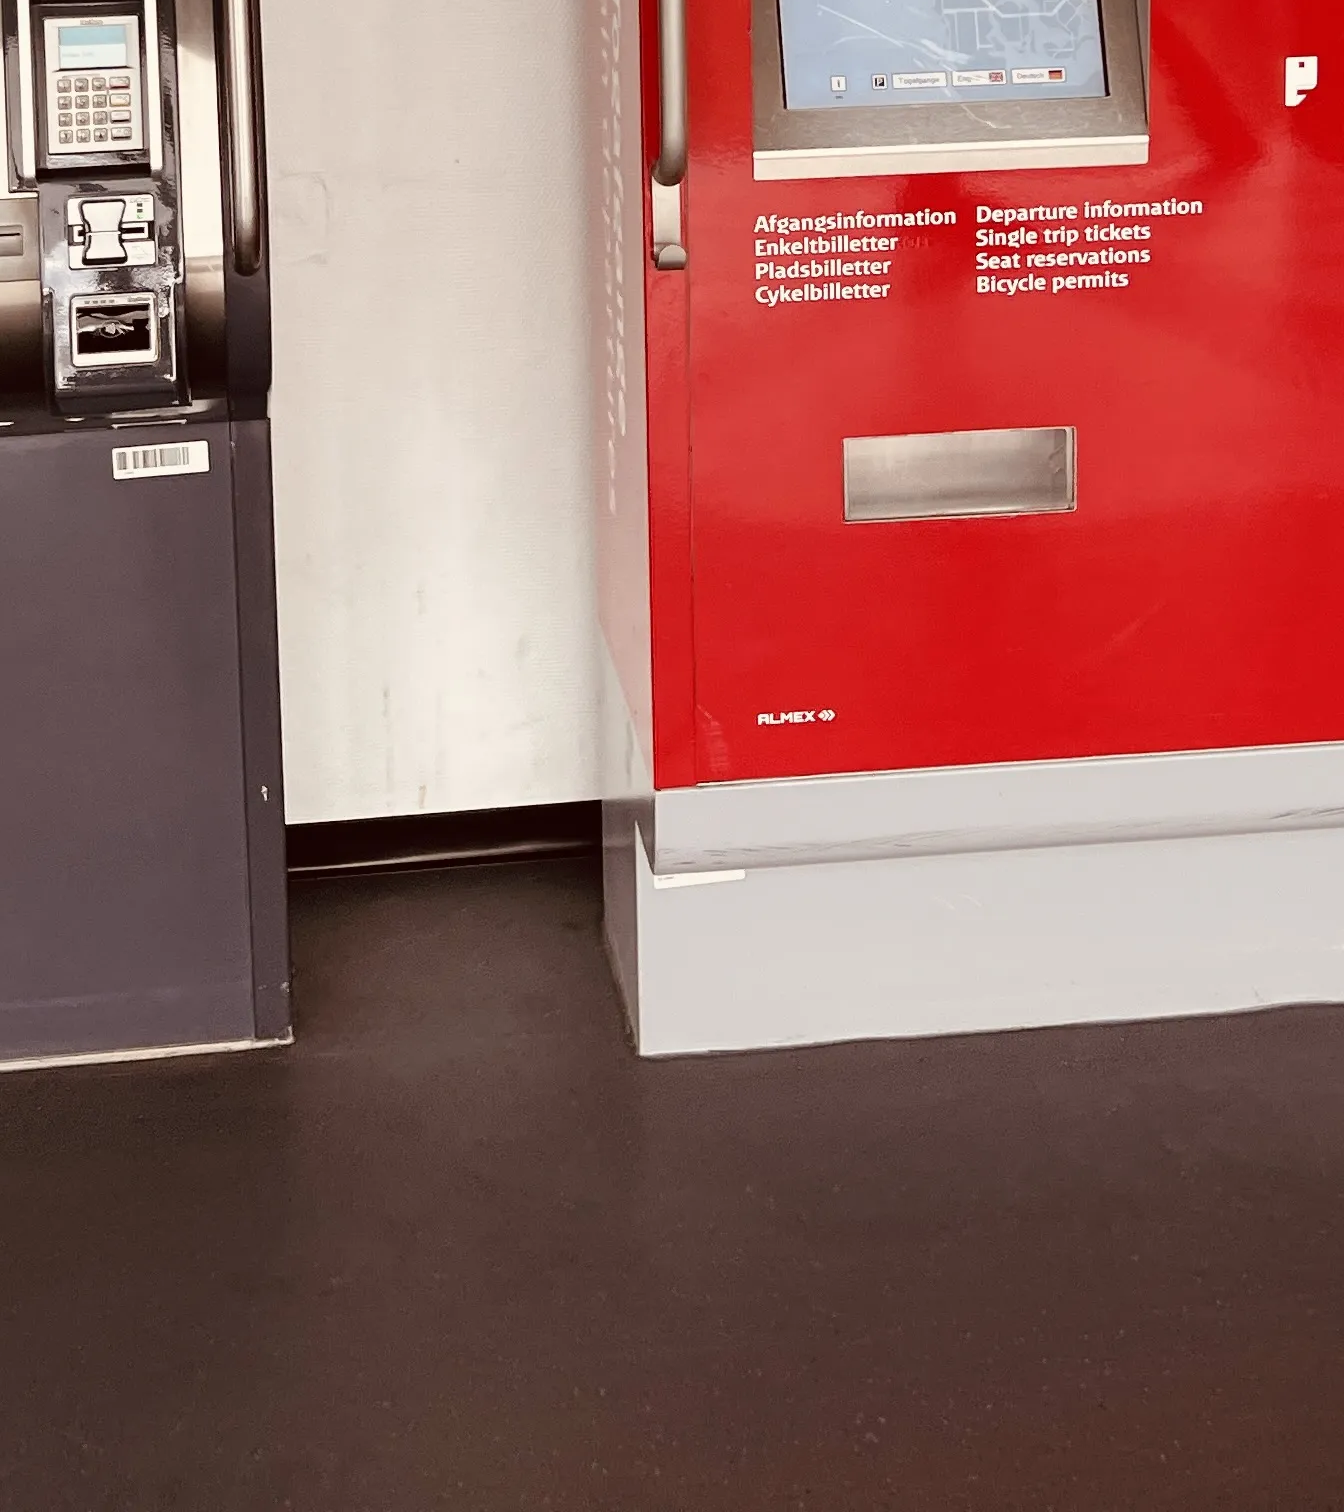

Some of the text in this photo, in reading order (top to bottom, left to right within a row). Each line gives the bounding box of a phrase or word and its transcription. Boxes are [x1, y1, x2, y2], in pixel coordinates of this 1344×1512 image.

[754, 208, 957, 235] Afgangsinformation
[976, 197, 1204, 226] Departure information
[755, 235, 899, 257] Enkeltbilletter
[975, 222, 1152, 249] Single trip tickets
[755, 256, 891, 280] Pladsbilletter
[975, 246, 1151, 271] Seat reservations
[755, 281, 890, 308] Cykelbilletter
[976, 270, 1130, 297] Bicycle permits
[757, 710, 816, 727] ALMEX
